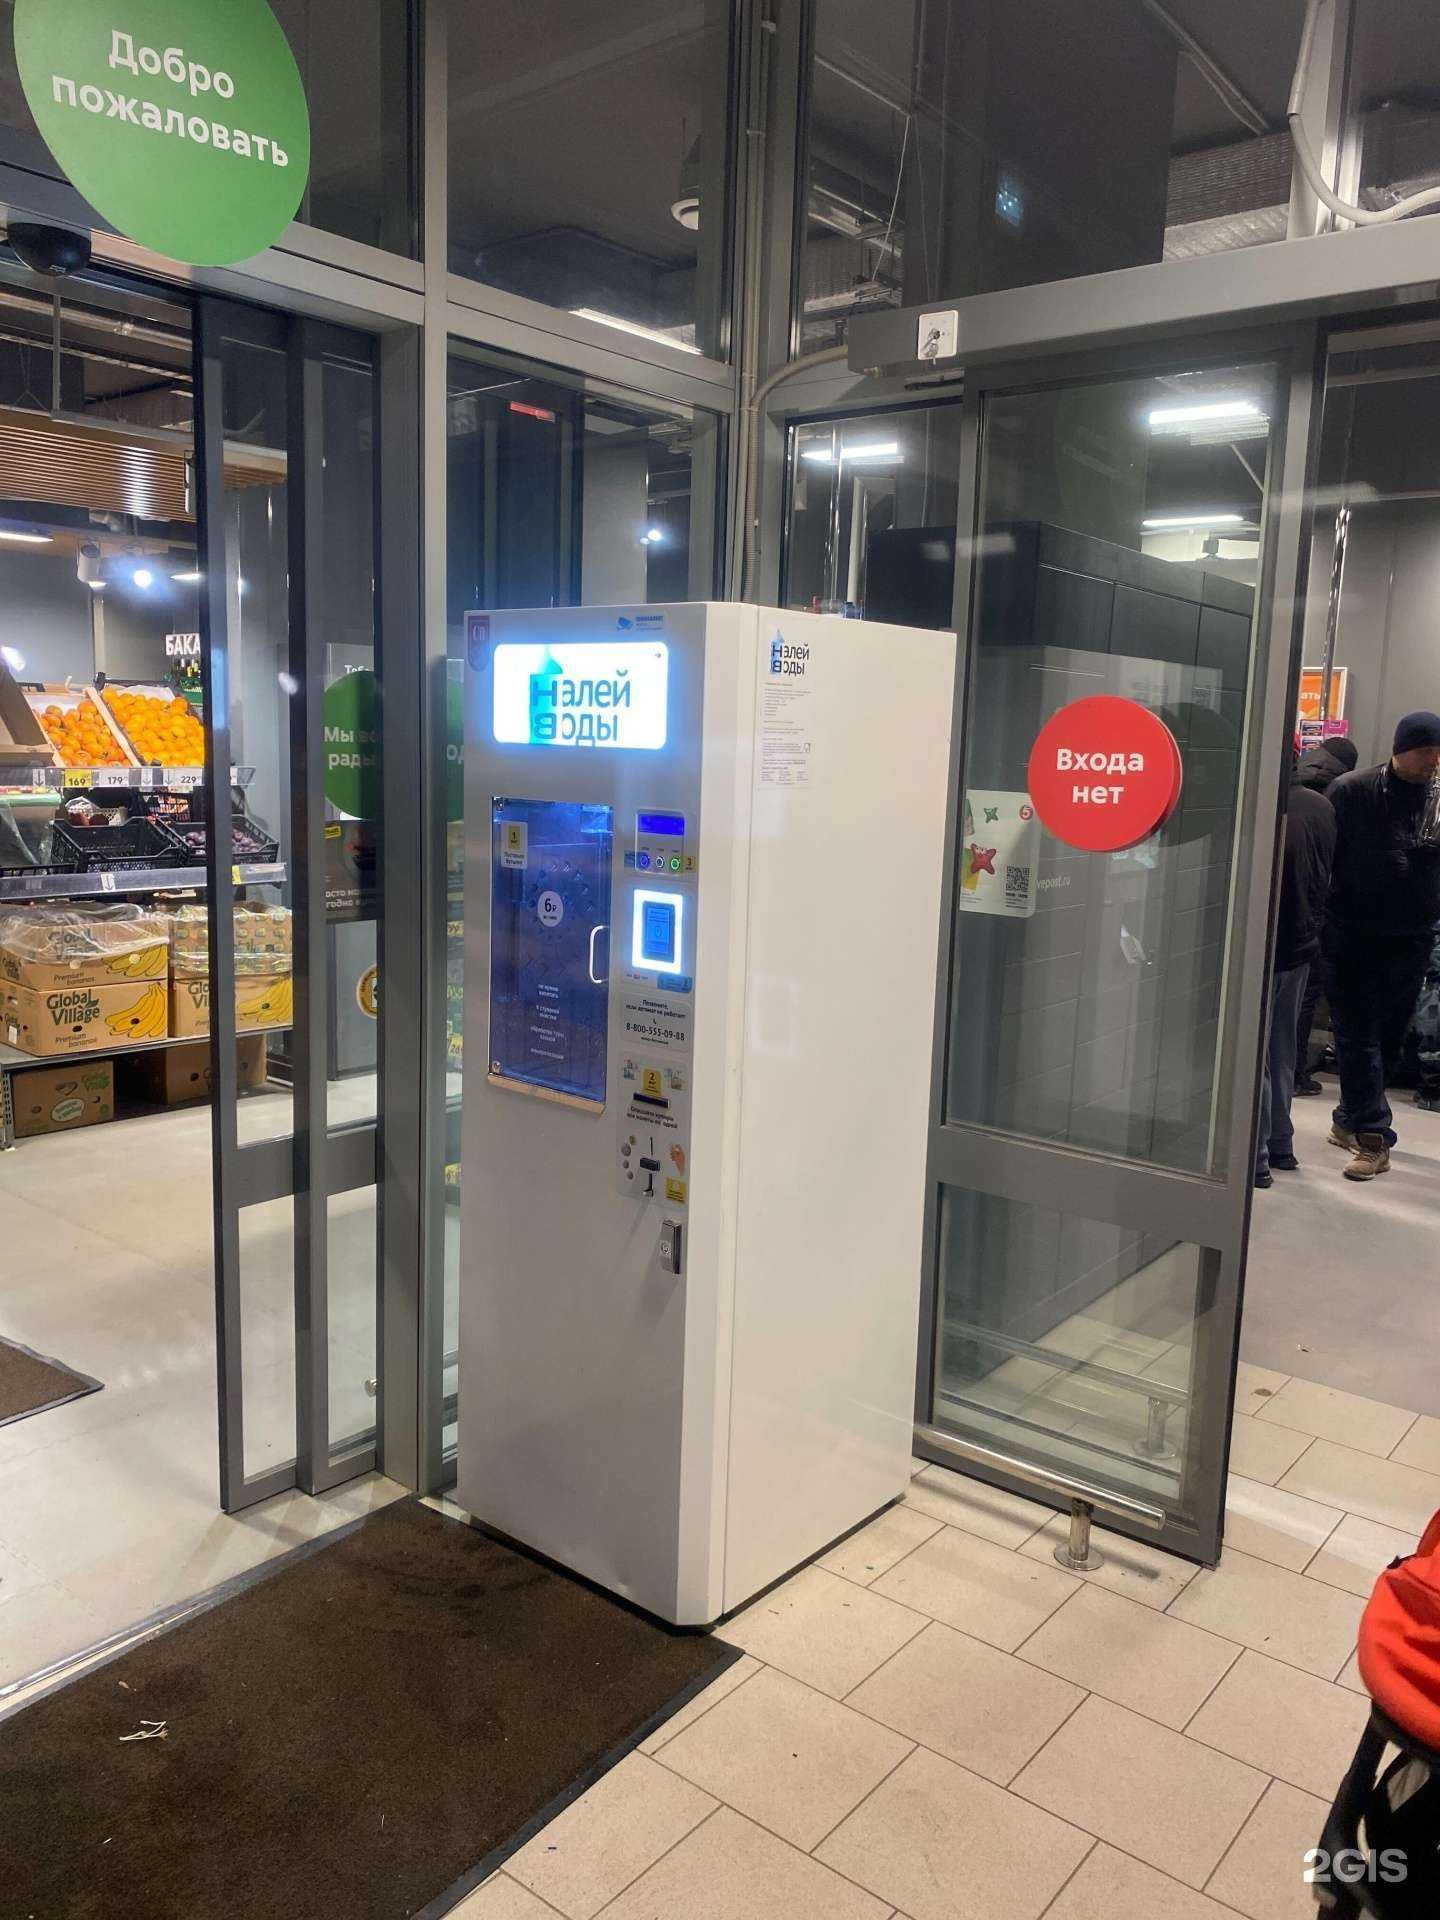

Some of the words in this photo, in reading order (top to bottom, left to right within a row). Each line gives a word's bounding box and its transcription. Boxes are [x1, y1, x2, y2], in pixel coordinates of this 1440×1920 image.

[108, 29, 235, 99] Добро
[52, 75, 289, 168] пожаловать
[165, 633, 201, 656] БАКА
[324, 726, 355, 742] Мы
[1056, 748, 1144, 775] Входа
[68, 778, 86, 786] 169
[107, 776, 123, 784] 179
[180, 775, 197, 784] 229
[1072, 785, 1125, 804] нет
[47, 989, 92, 1010] Global
